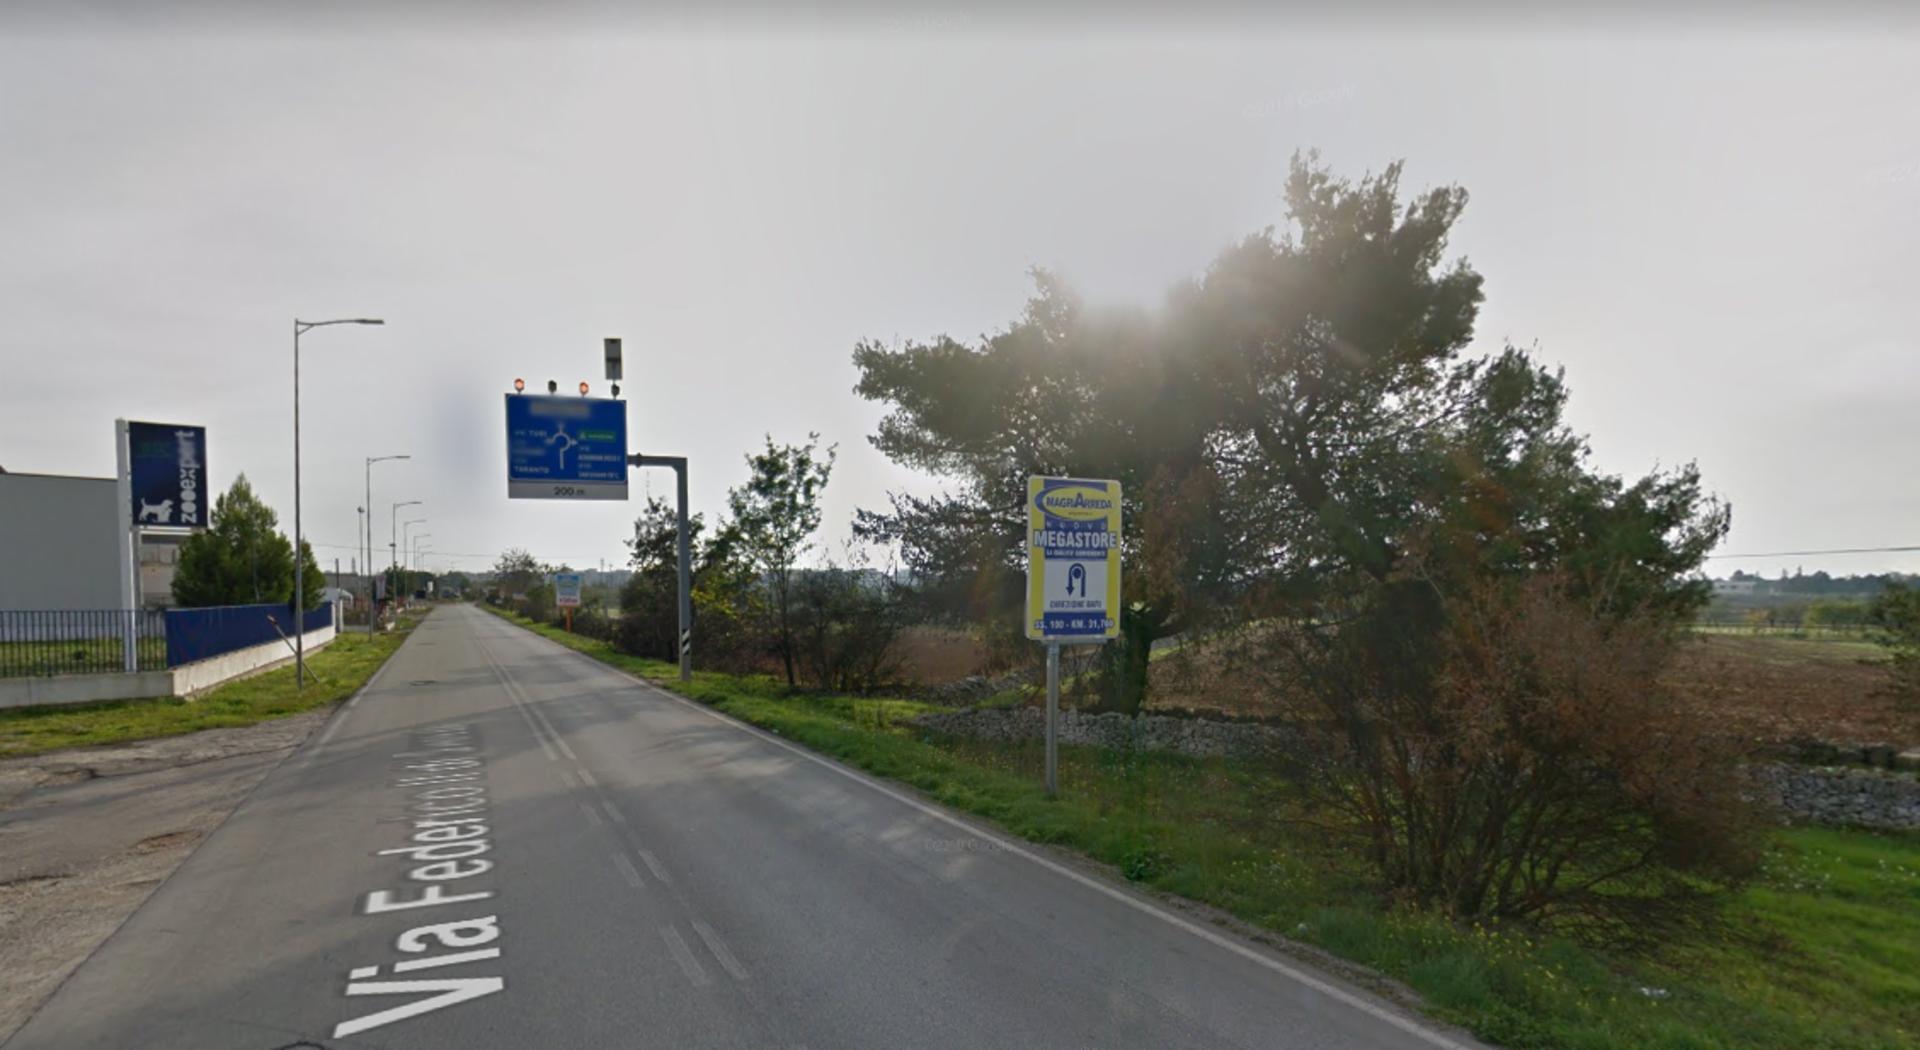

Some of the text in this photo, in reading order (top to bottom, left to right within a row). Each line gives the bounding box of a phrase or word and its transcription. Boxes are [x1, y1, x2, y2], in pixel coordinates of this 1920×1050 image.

[174, 429, 200, 524] zooexpt
[553, 486, 574, 497] 200
[1034, 530, 1117, 549] MEGASTORE
